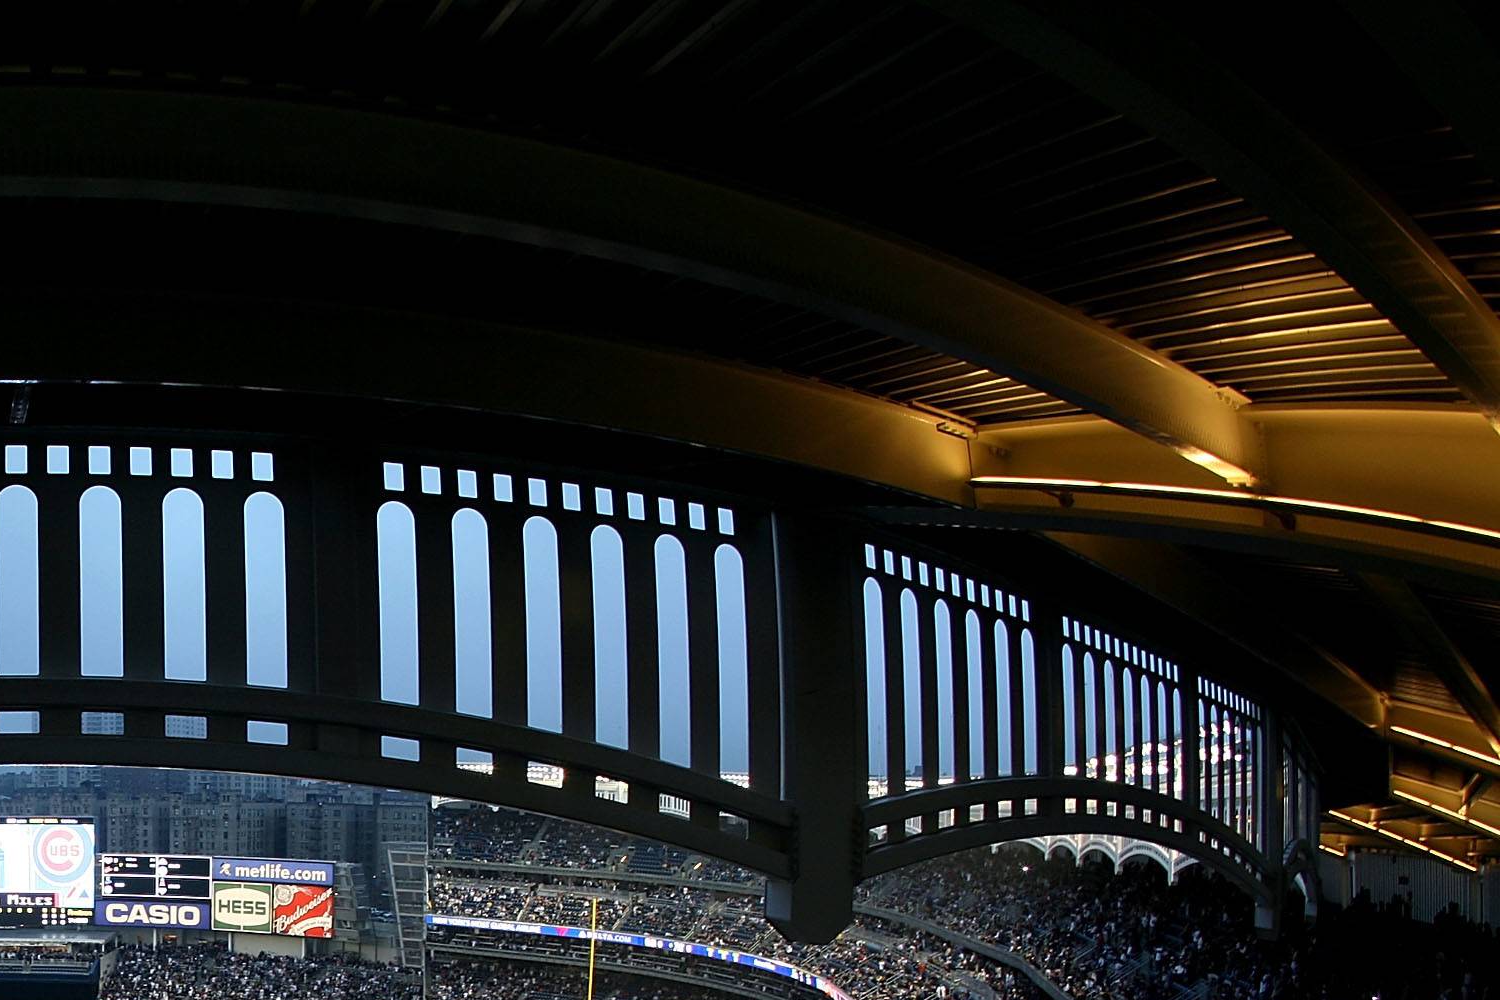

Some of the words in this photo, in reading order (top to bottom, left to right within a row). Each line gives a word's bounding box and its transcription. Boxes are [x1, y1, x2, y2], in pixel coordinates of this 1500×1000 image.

[42, 830, 79, 871] CUBS
[235, 864, 326, 882] metlife.com
[105, 903, 201, 926] CASIO
[218, 899, 266, 916] HESS
[273, 887, 333, 934] Budweiser
